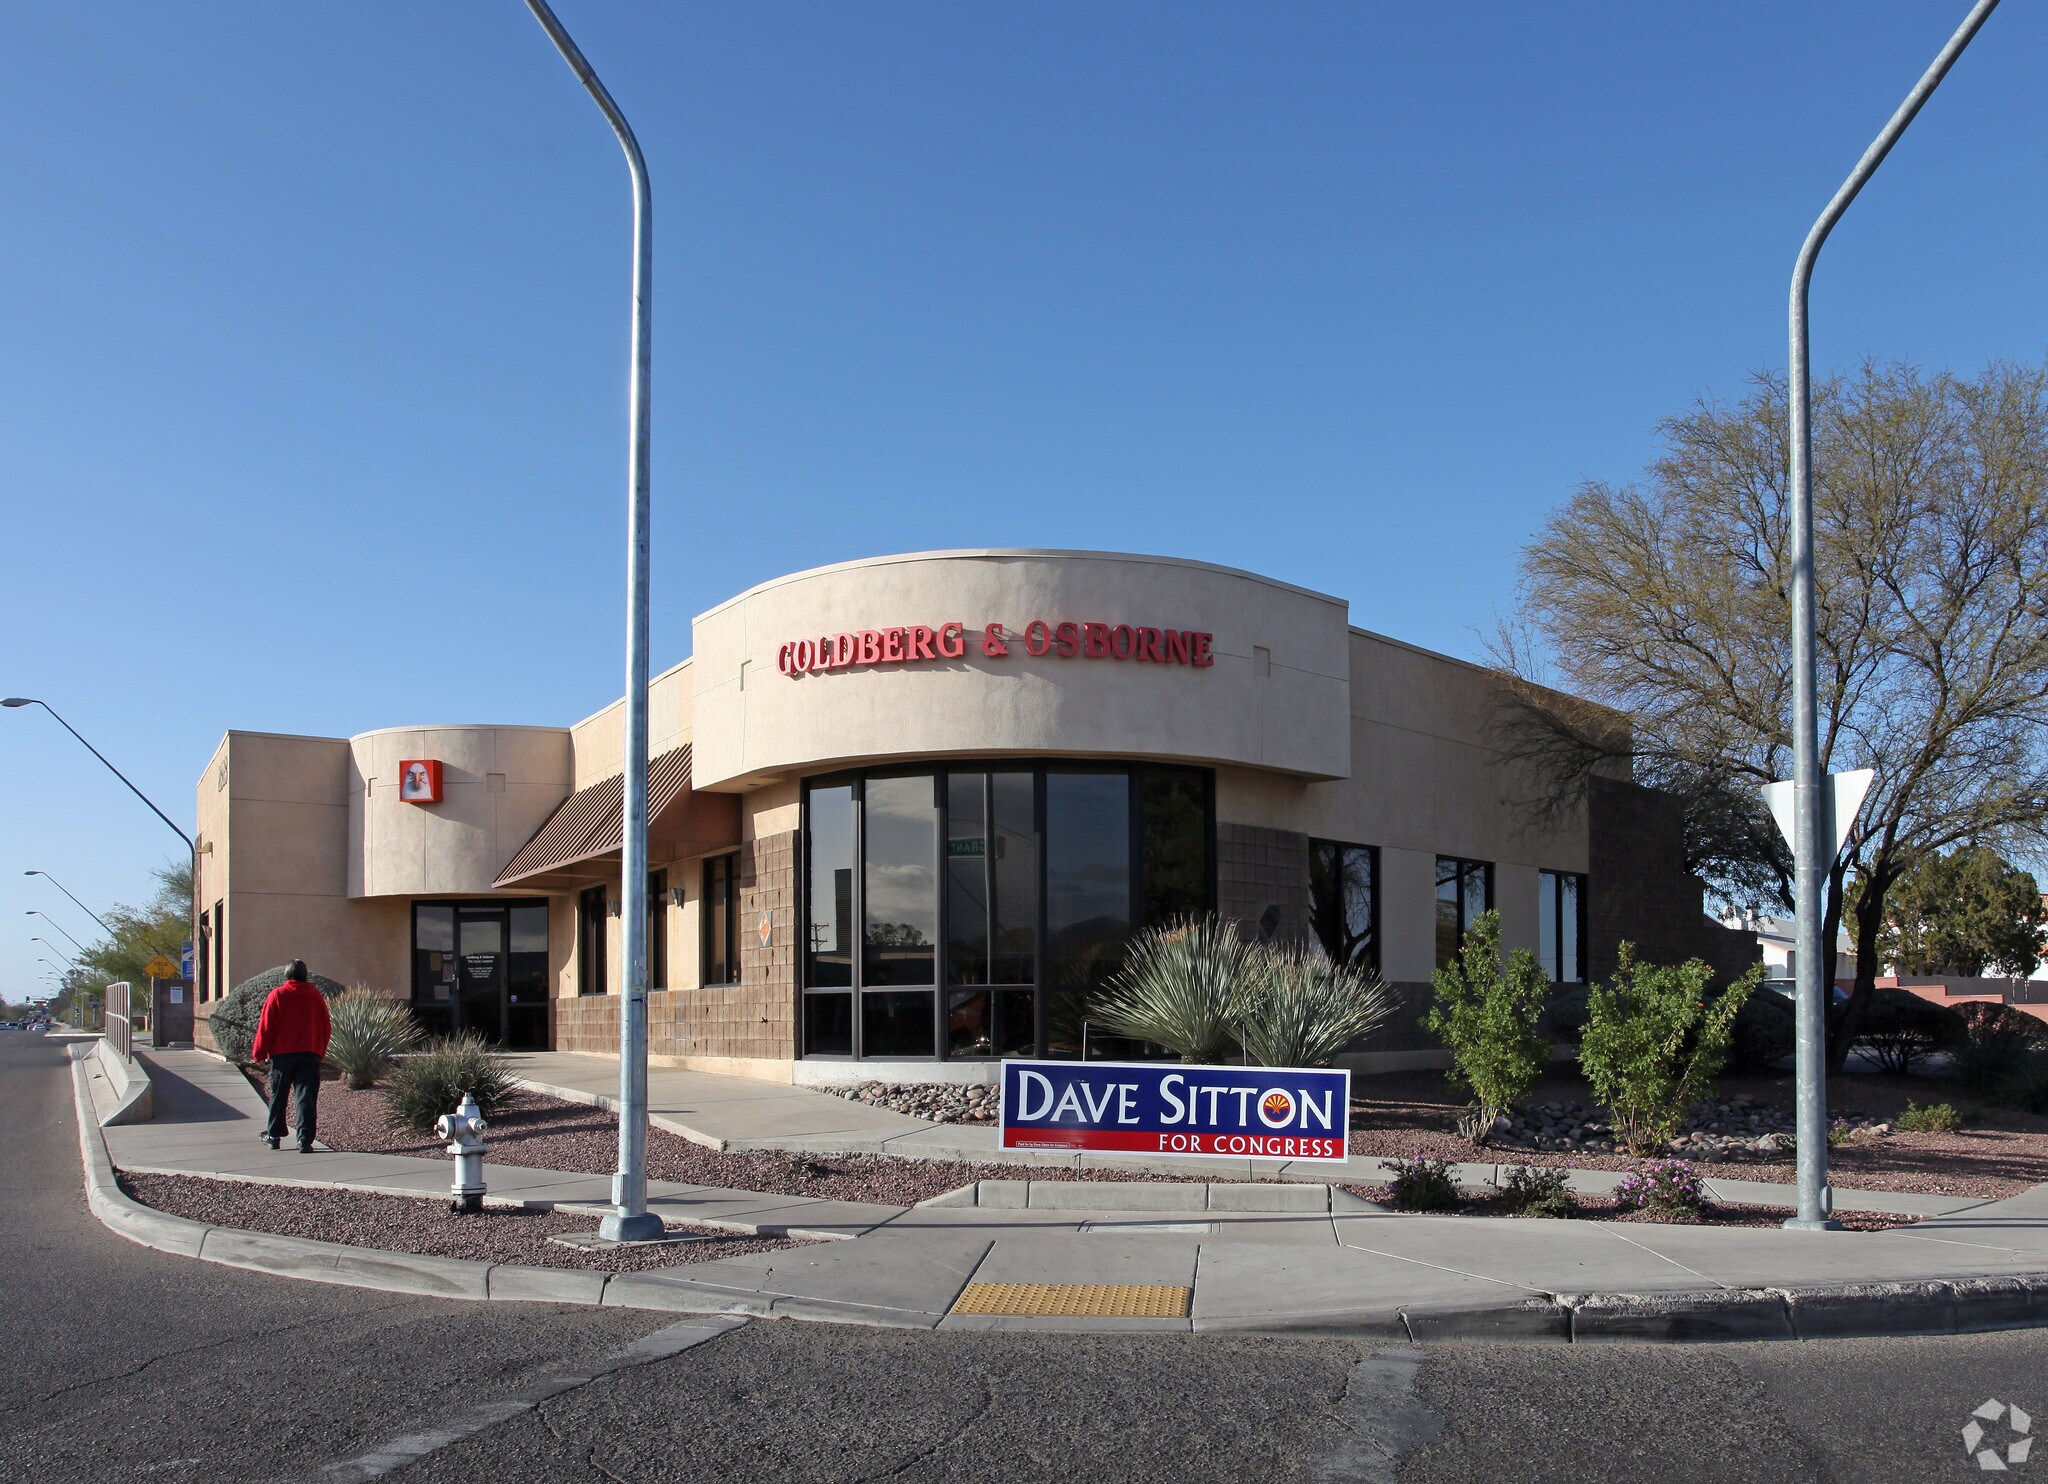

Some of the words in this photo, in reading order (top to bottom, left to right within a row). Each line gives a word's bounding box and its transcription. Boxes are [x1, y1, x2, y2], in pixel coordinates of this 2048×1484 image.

[775, 622, 964, 676] GOLDBERG
[982, 623, 1009, 657] &
[1024, 620, 1214, 667] OSBORNE
[1017, 1071, 1140, 1124] DAVE
[1160, 1074, 1332, 1129] SITTON
[1159, 1134, 1201, 1151] FOR
[1214, 1136, 1333, 1156] CONGRESS
